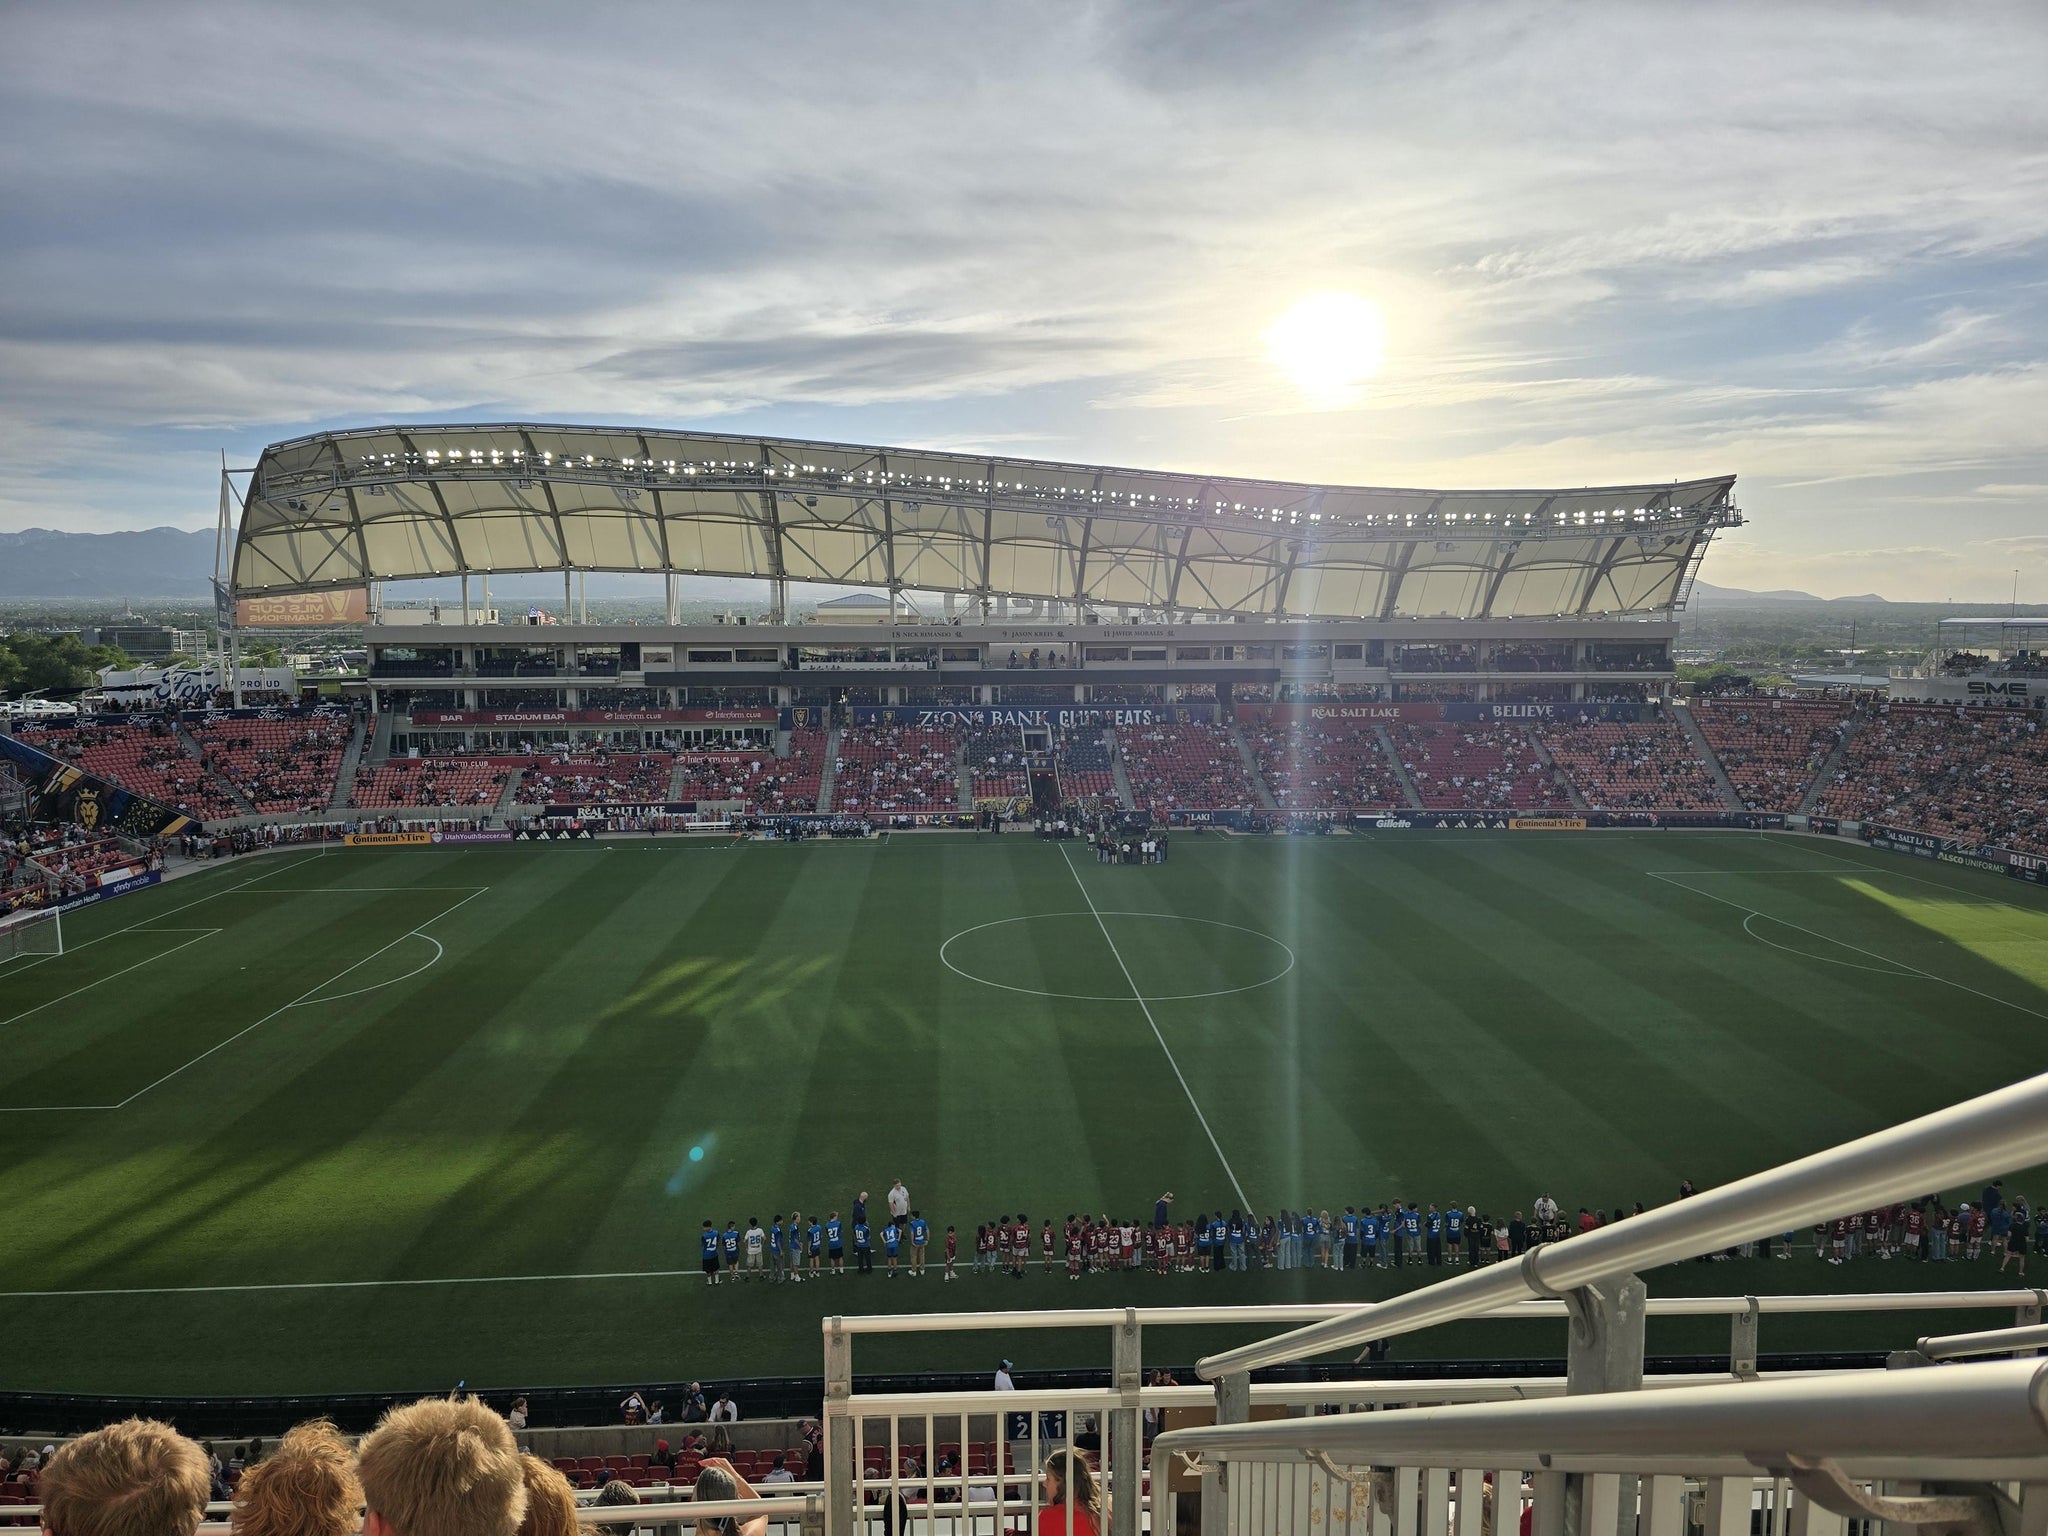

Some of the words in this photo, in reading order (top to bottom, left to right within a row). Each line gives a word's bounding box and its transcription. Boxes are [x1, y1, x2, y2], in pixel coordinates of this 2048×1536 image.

[1967, 681, 2028, 696] SME
[205, 711, 230, 721] Ford
[1340, 707, 1369, 718] SALT
[1371, 707, 1400, 718] LAKE
[1492, 705, 1555, 717] BELIEVE
[495, 713, 542, 721] STADIUM
[990, 710, 1050, 726] BANK
[1103, 710, 1153, 726] EATS
[21, 721, 48, 733] Ford
[73, 717, 99, 729] Ford
[606, 805, 634, 816] SALT
[1375, 819, 1412, 828] Gillette
[1515, 819, 1557, 829] Continental
[1563, 819, 1581, 828] Tire
[352, 834, 399, 844] Continental
[404, 833, 425, 843] Tire
[444, 832, 511, 842] UtahYouthSoccer.net
[1898, 833, 1916, 844] SALT
[1937, 851, 1965, 865] ALSCO
[113, 881, 131, 894] xfinity
[131, 875, 150, 887] mobile
[83, 892, 101, 903] Health
[1406, 1219, 1417, 1228] 33
[1450, 1218, 1460, 1227] 18
[1909, 1214, 1920, 1225] 36
[916, 1226, 922, 1236] 8
[1215, 1226, 1226, 1236] 23
[1307, 1222, 1314, 1232] 2
[1367, 1224, 1374, 1234] 3
[1559, 1224, 1567, 1233] 31
[1838, 1221, 1845, 1230] 2
[827, 1227, 839, 1238] 27
[855, 1230, 864, 1240] 10
[886, 1230, 894, 1239] 14
[705, 1236, 718, 1248] 74
[725, 1237, 737, 1248] 25
[749, 1234, 761, 1245] 26
[987, 1235, 994, 1244] 9
[1043, 1233, 1051, 1244] 6
[1109, 1235, 1120, 1245] 23
[1145, 1235, 1152, 1244] 3
[1157, 1239, 1166, 1249] 10
[1177, 1234, 1186, 1245] 11
[1071, 1240, 1081, 1250] 13
[1016, 1421, 1028, 1439] 2
[1054, 1420, 1062, 1438] 1
